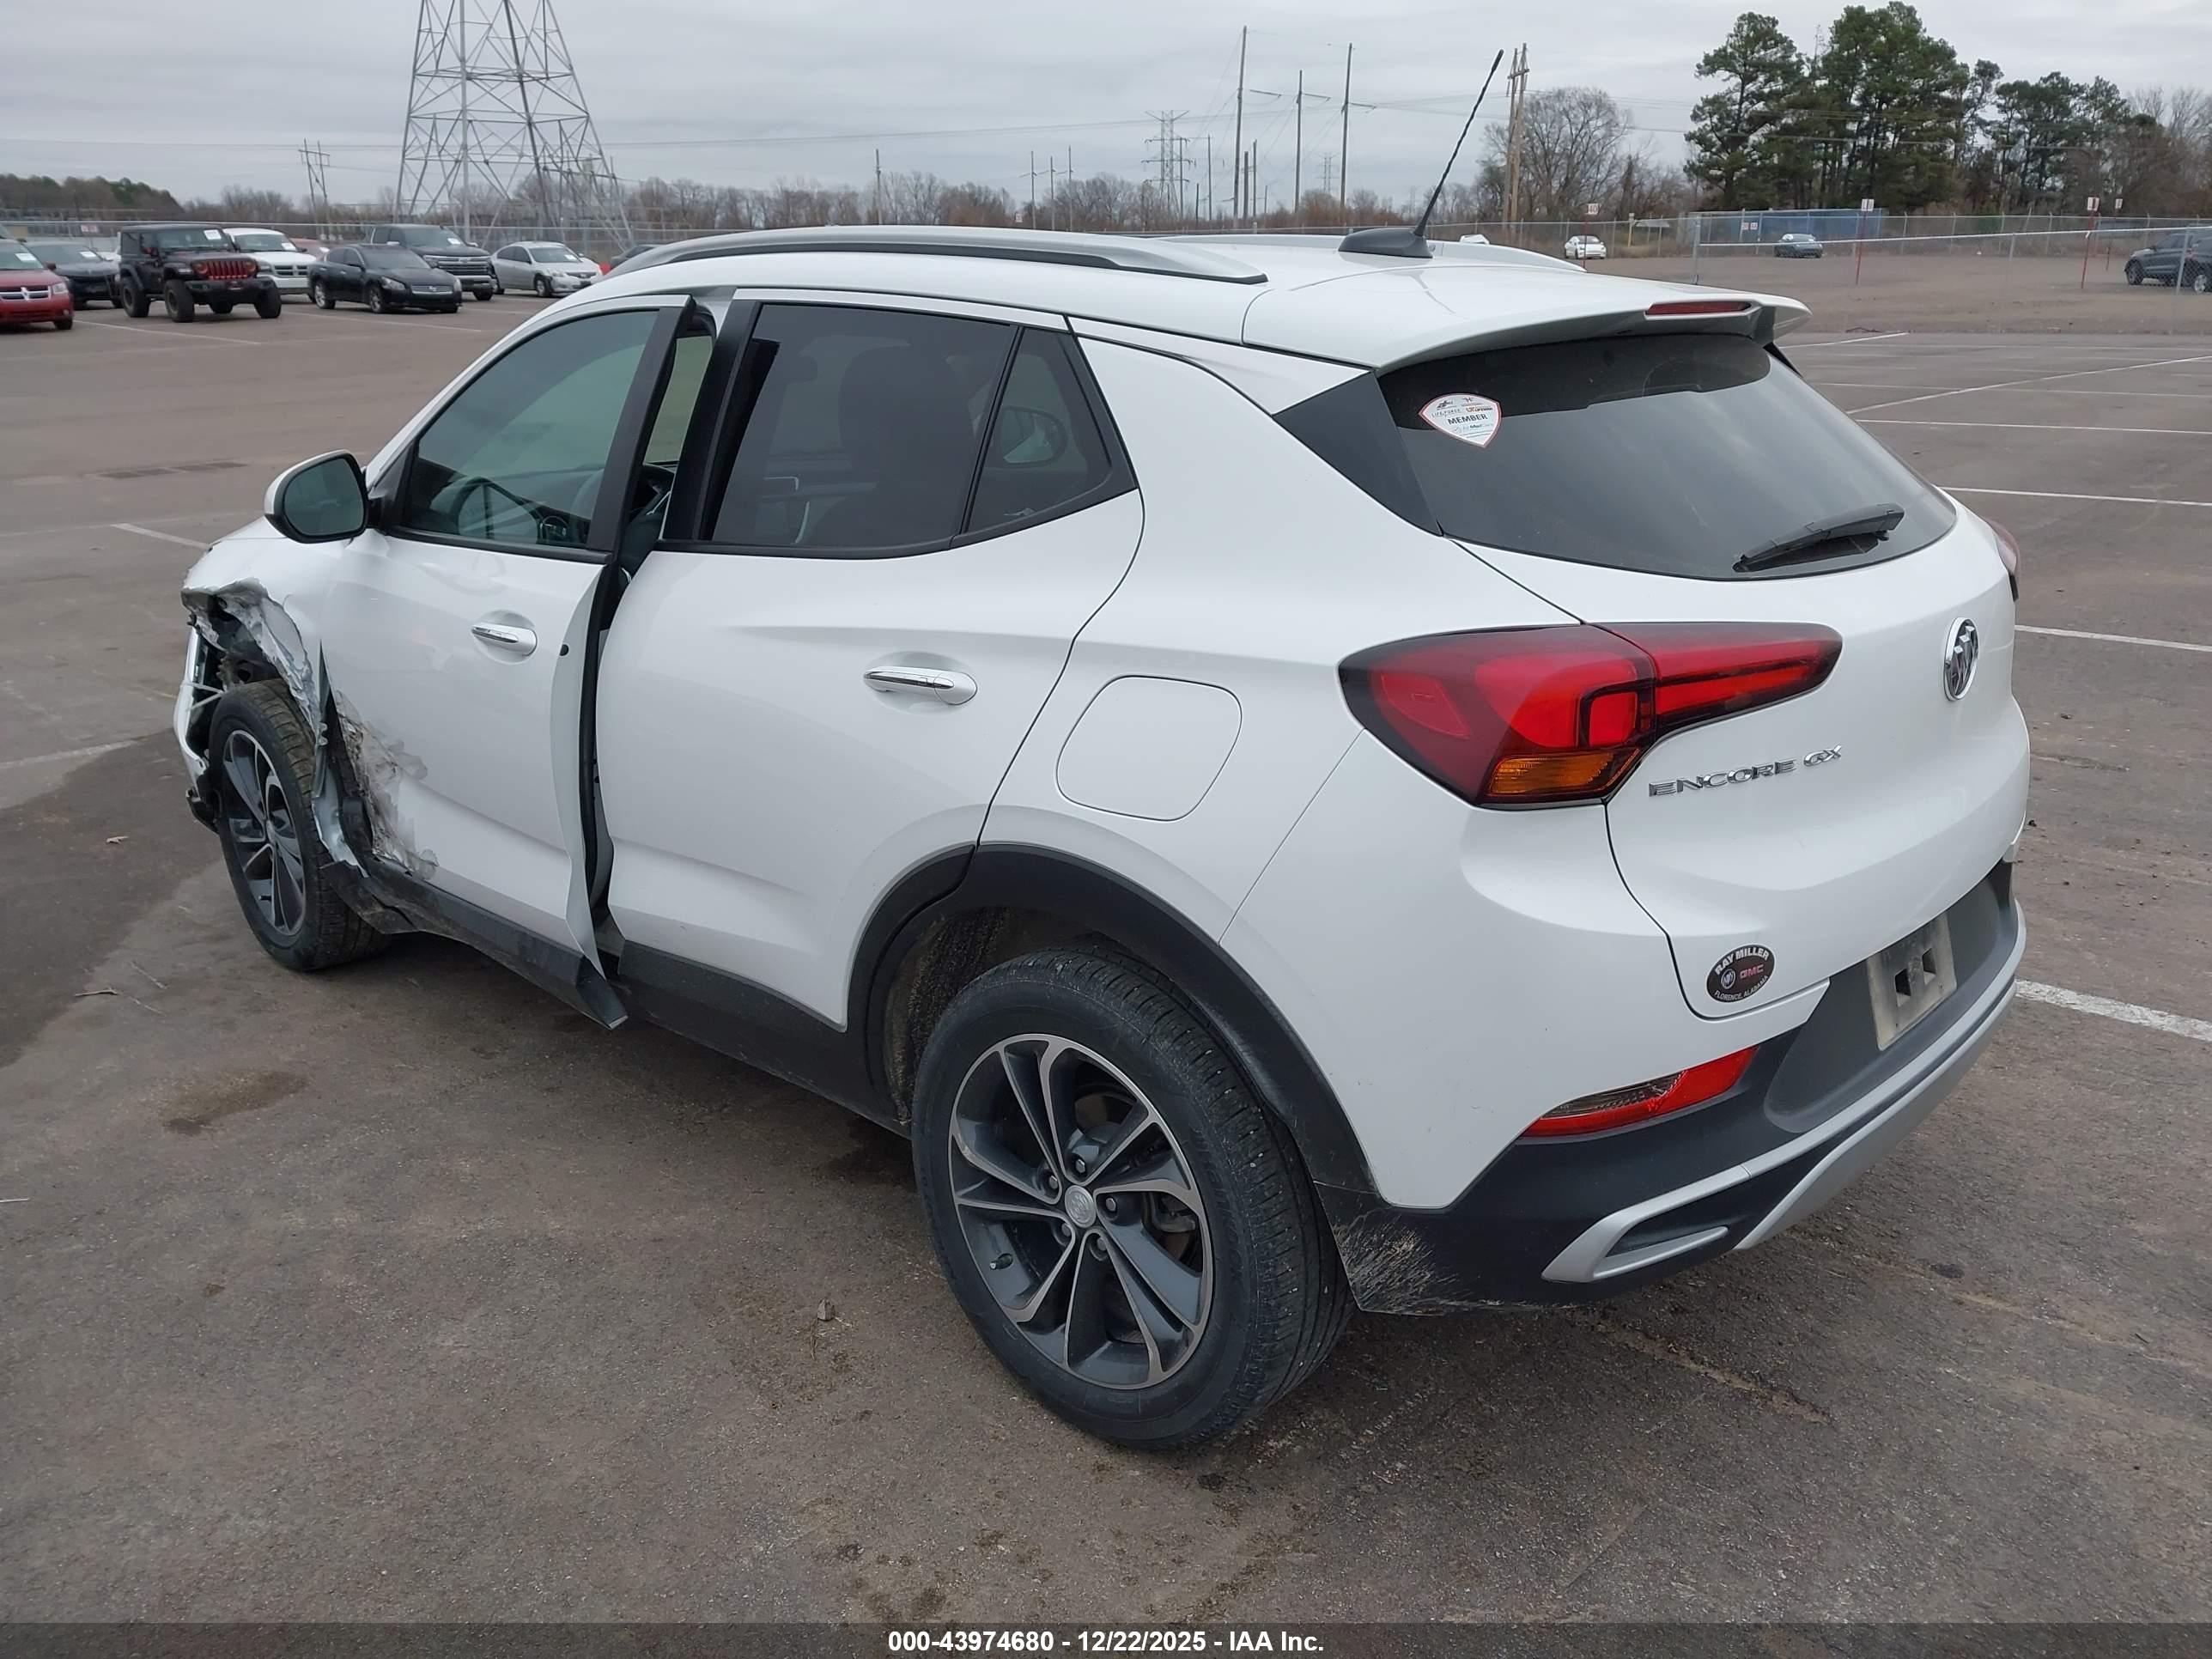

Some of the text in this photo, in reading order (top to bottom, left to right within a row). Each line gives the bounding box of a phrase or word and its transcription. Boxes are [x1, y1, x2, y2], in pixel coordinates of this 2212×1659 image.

[1447, 413, 1488, 425] MEMBER
[1649, 742, 1843, 797] ENCORE GX
[1714, 946, 1770, 975] RAY MILLER
[1740, 963, 1765, 979] GMC
[1743, 975, 1769, 997] ALABAMA
